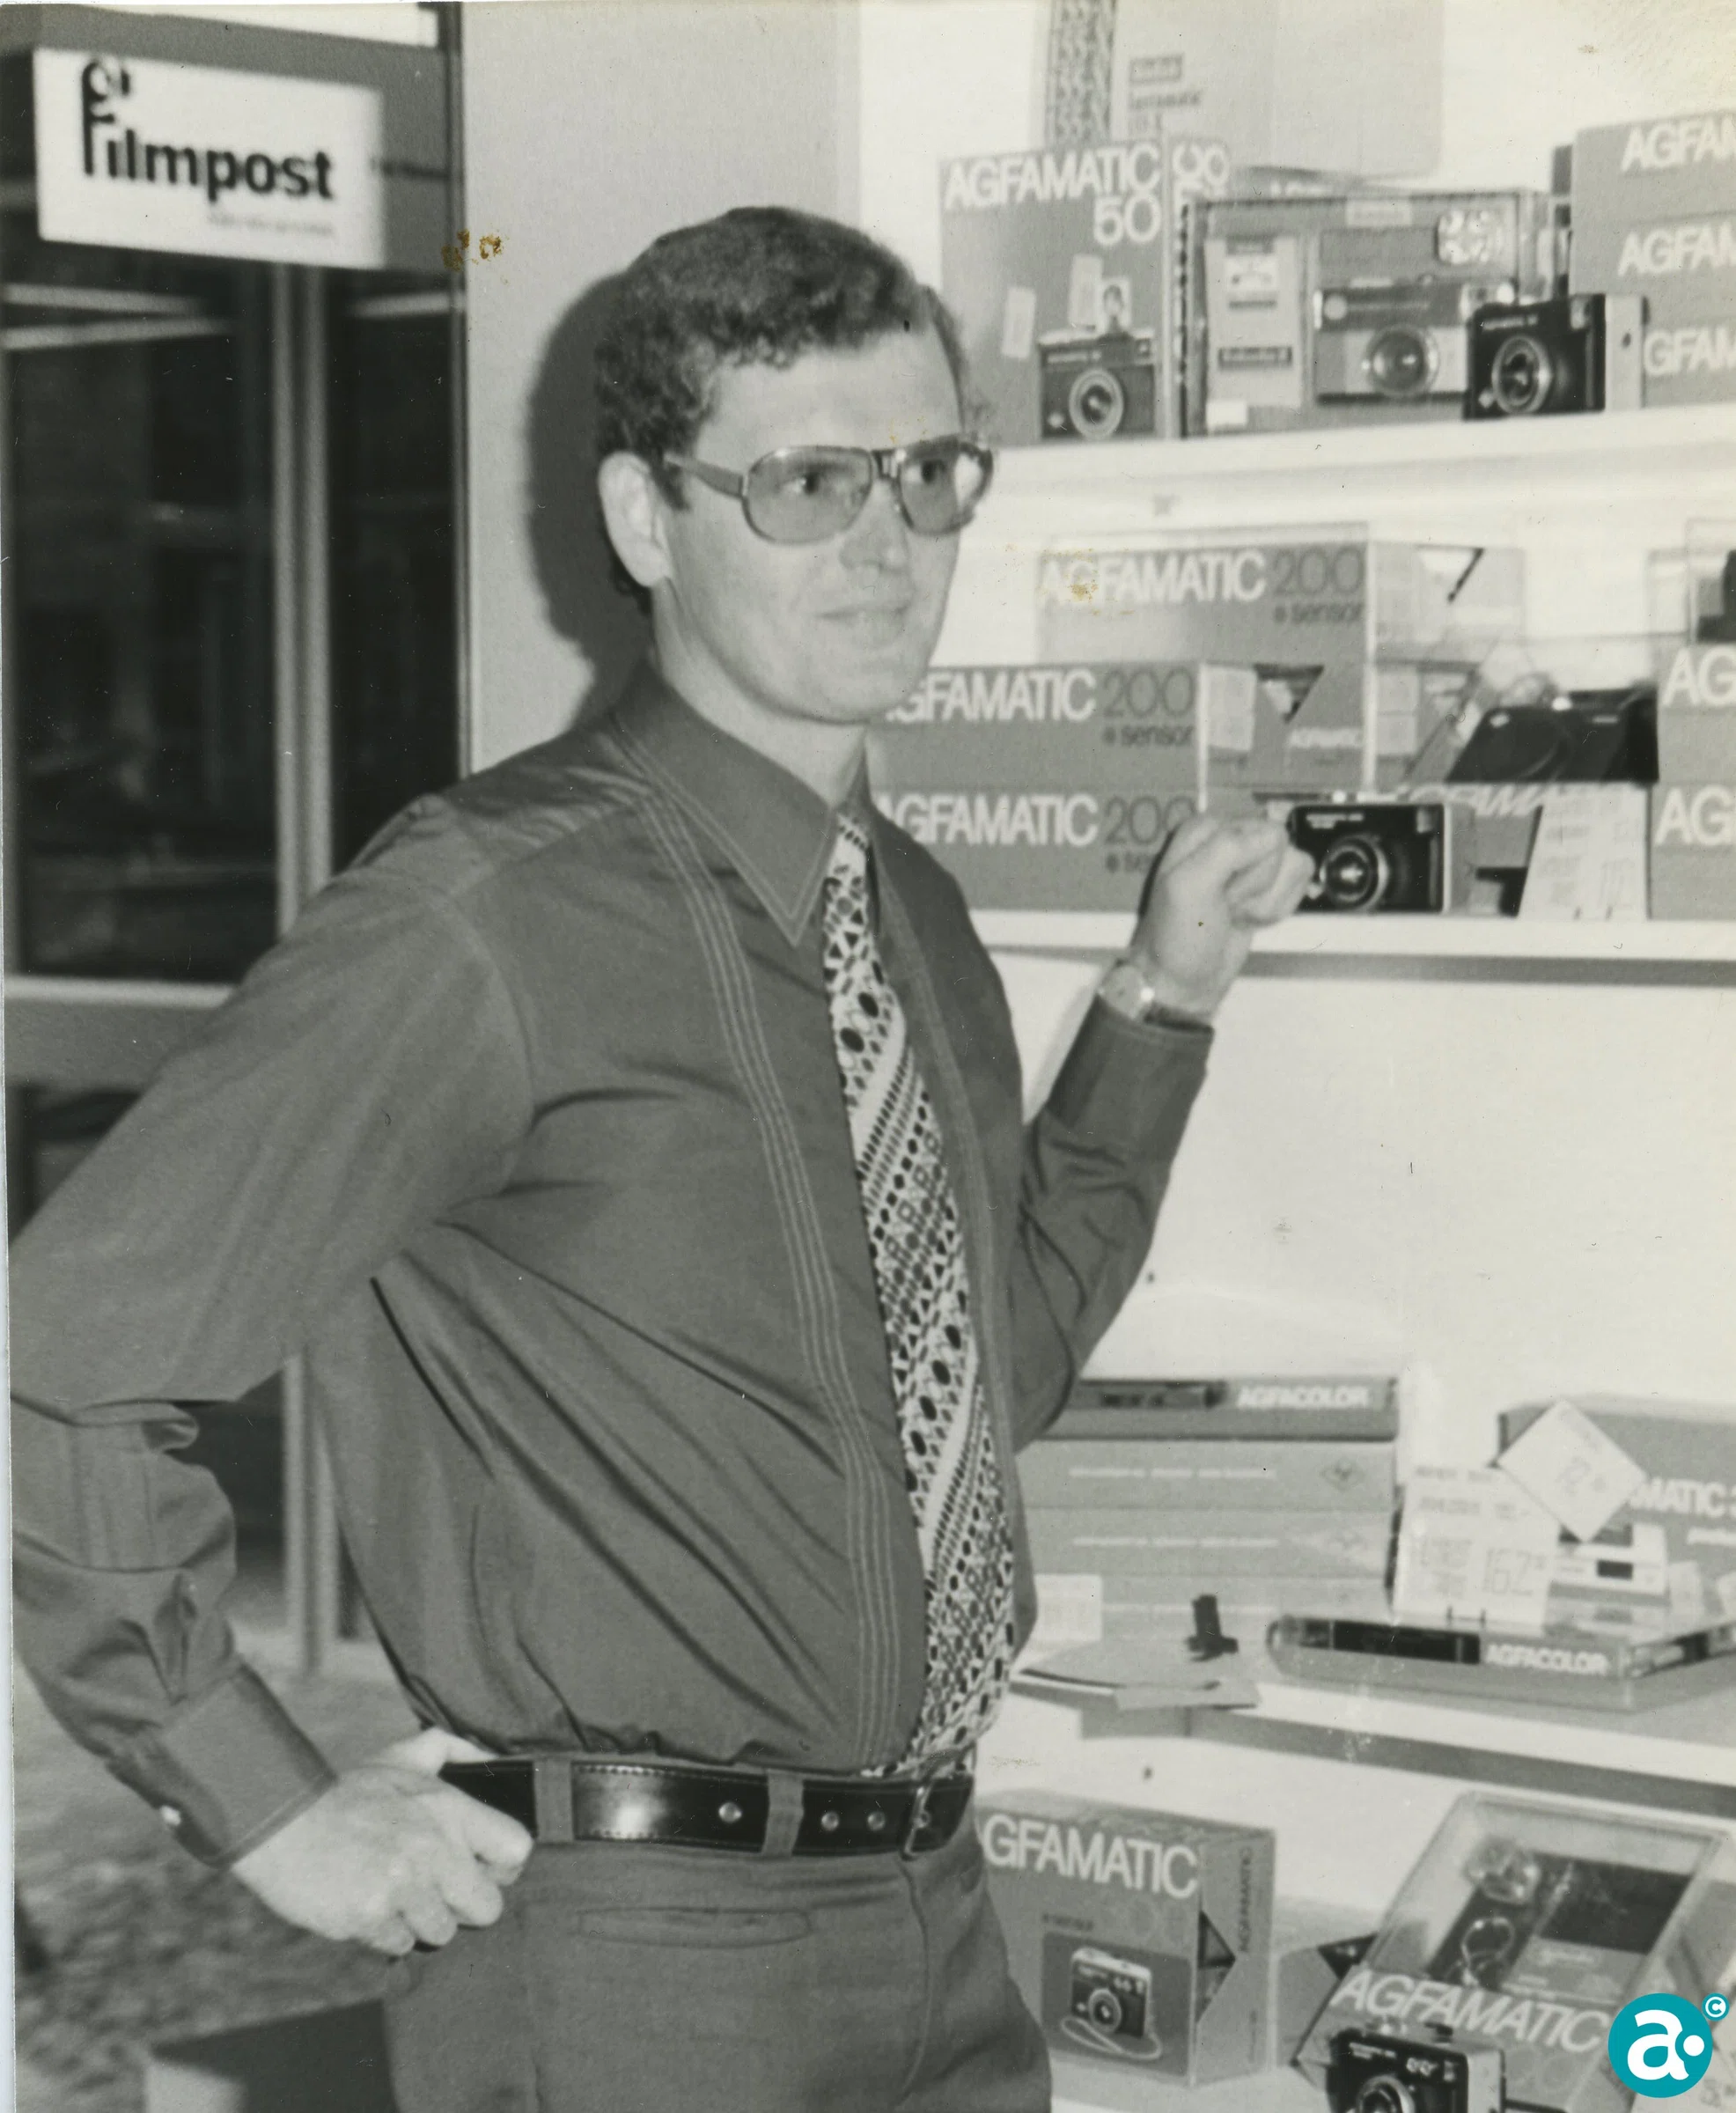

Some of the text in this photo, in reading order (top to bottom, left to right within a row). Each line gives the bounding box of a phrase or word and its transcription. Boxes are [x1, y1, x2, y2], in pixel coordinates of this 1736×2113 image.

[944, 142, 1159, 211] AGFAMATIC
[1041, 545, 1365, 604] AGFAMATIC 200
[886, 666, 1195, 723] GFAMATIC 200
[1237, 1385, 1369, 1410] AGFACOLOR
[1485, 1642, 1609, 1676] AGFACOLOR
[1329, 1969, 1611, 2053] AGFAMATIC
